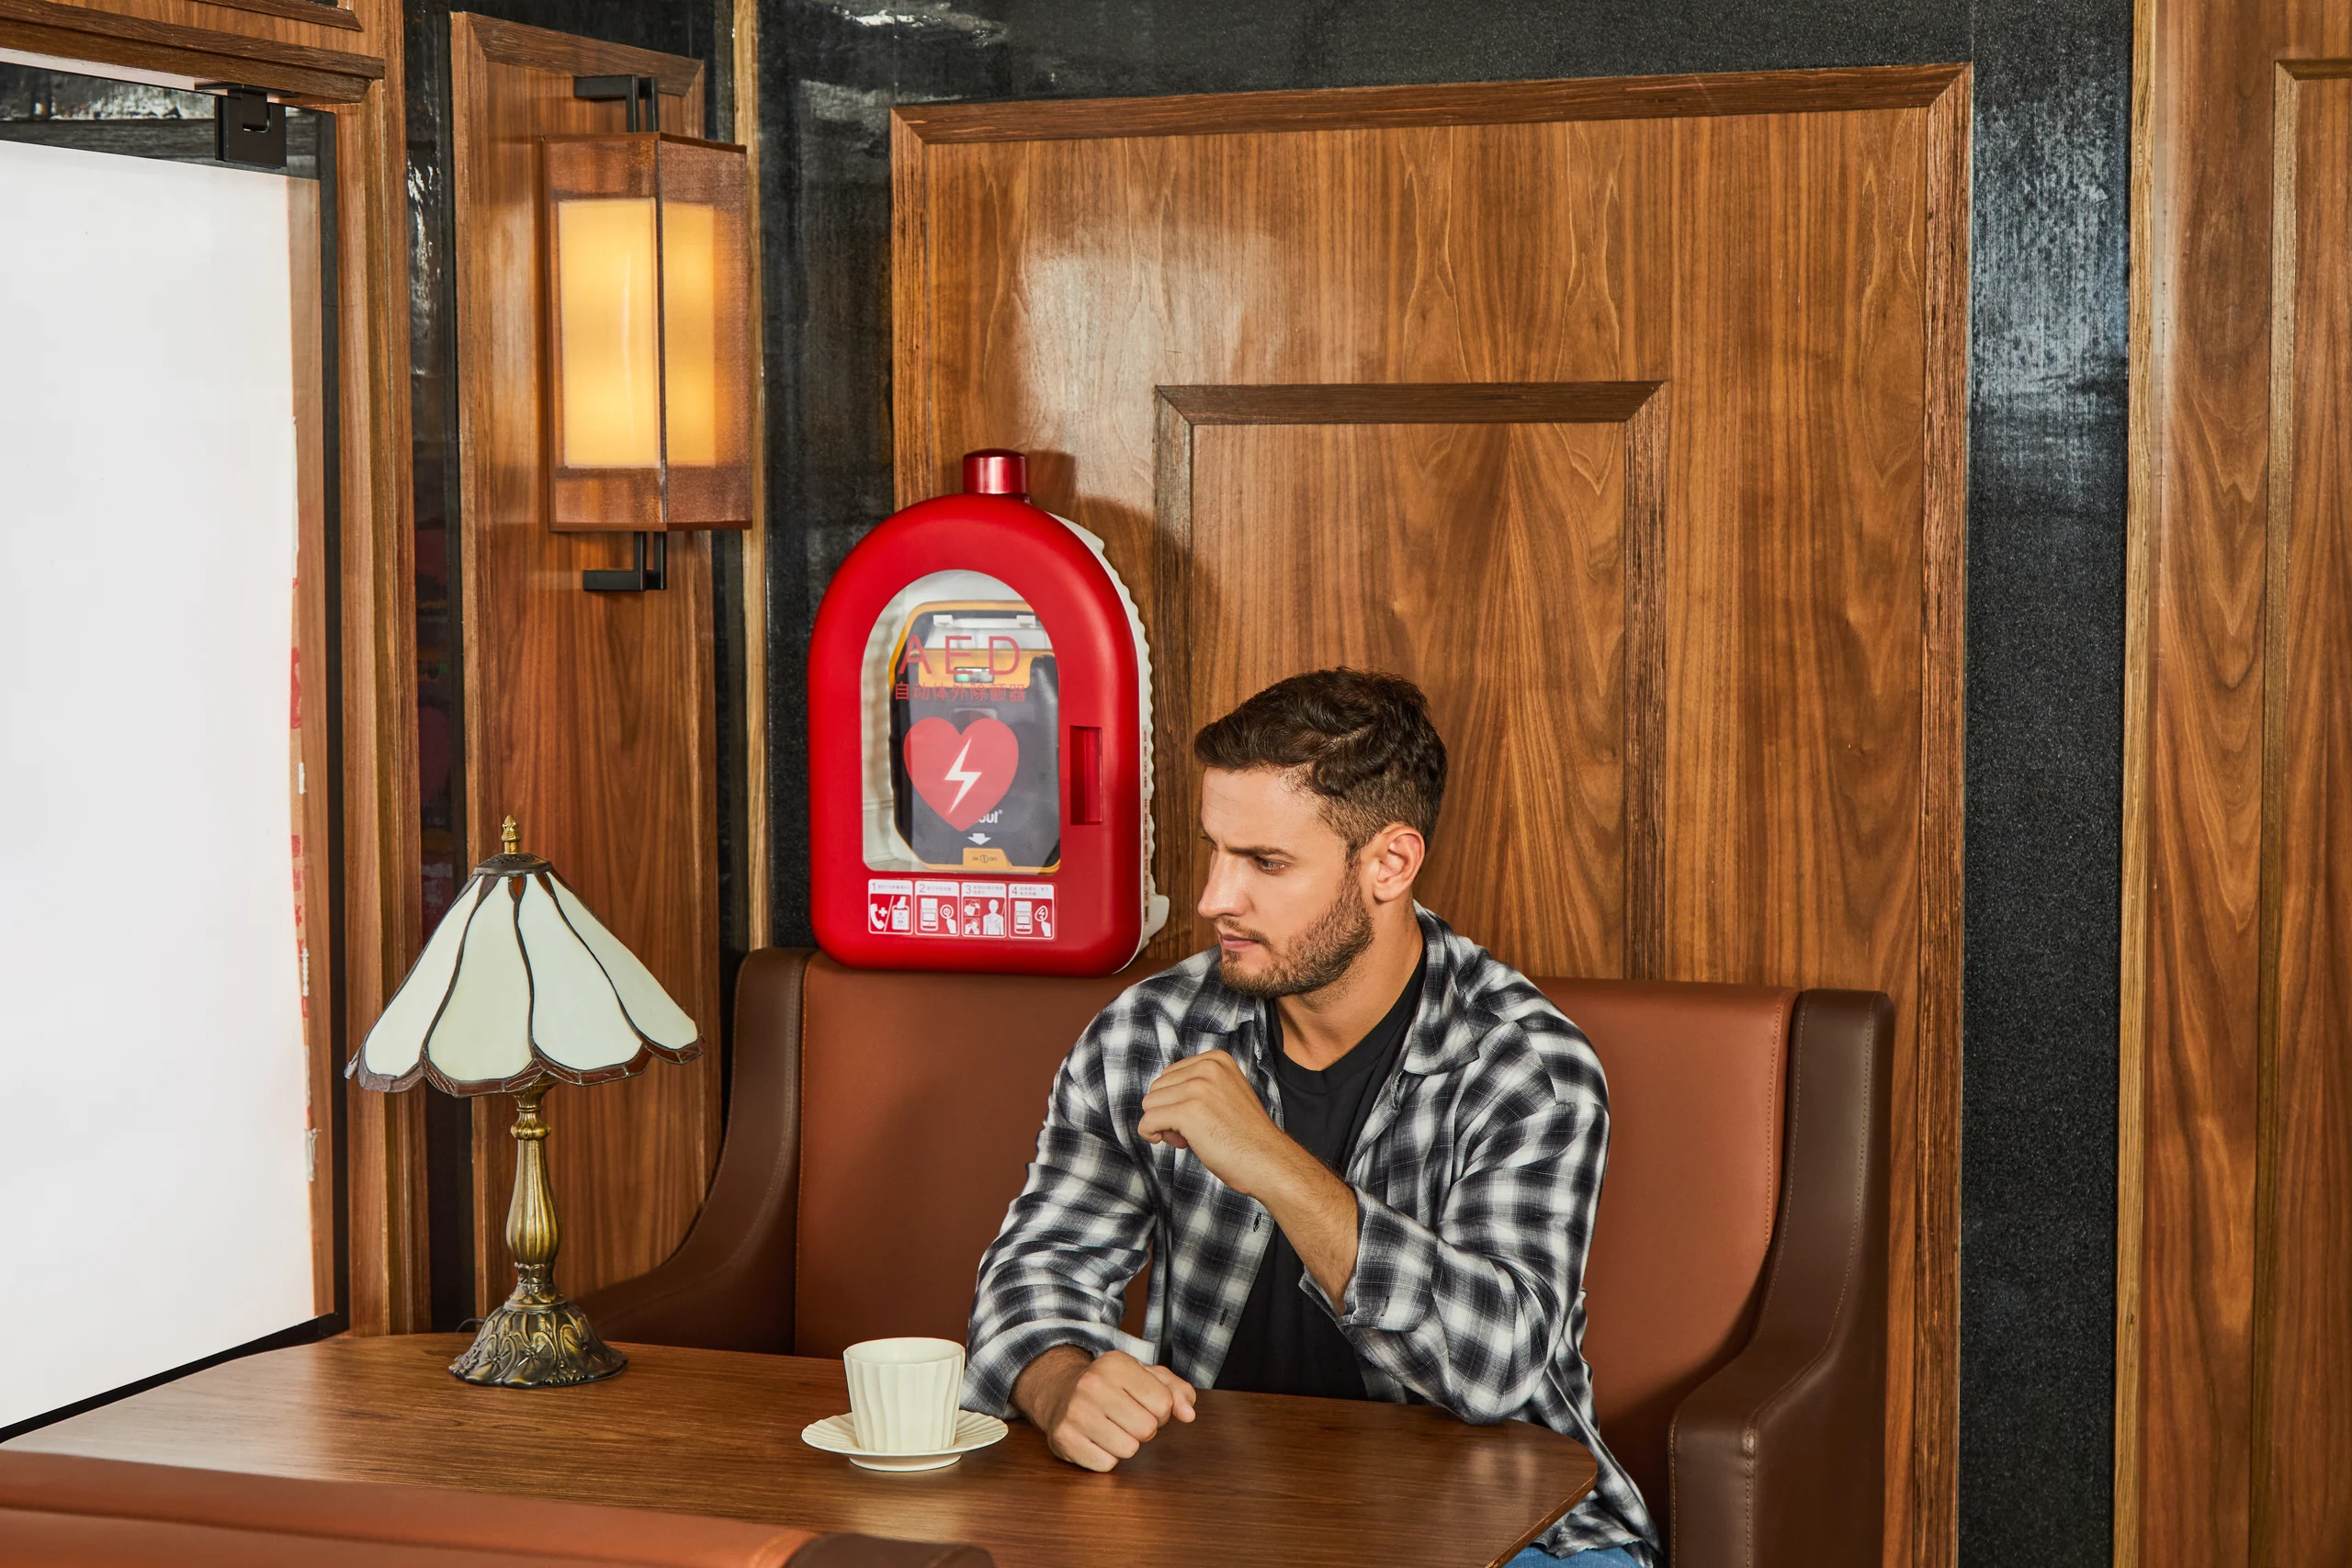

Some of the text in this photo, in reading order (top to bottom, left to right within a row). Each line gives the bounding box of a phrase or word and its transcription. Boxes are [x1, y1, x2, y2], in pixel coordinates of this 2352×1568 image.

[898, 634, 1021, 675] AED
[895, 682, 1026, 703] 自动体外除颤器
[919, 883, 925, 893] 2
[965, 885, 971, 894] 3
[1012, 886, 1017, 896] 4
